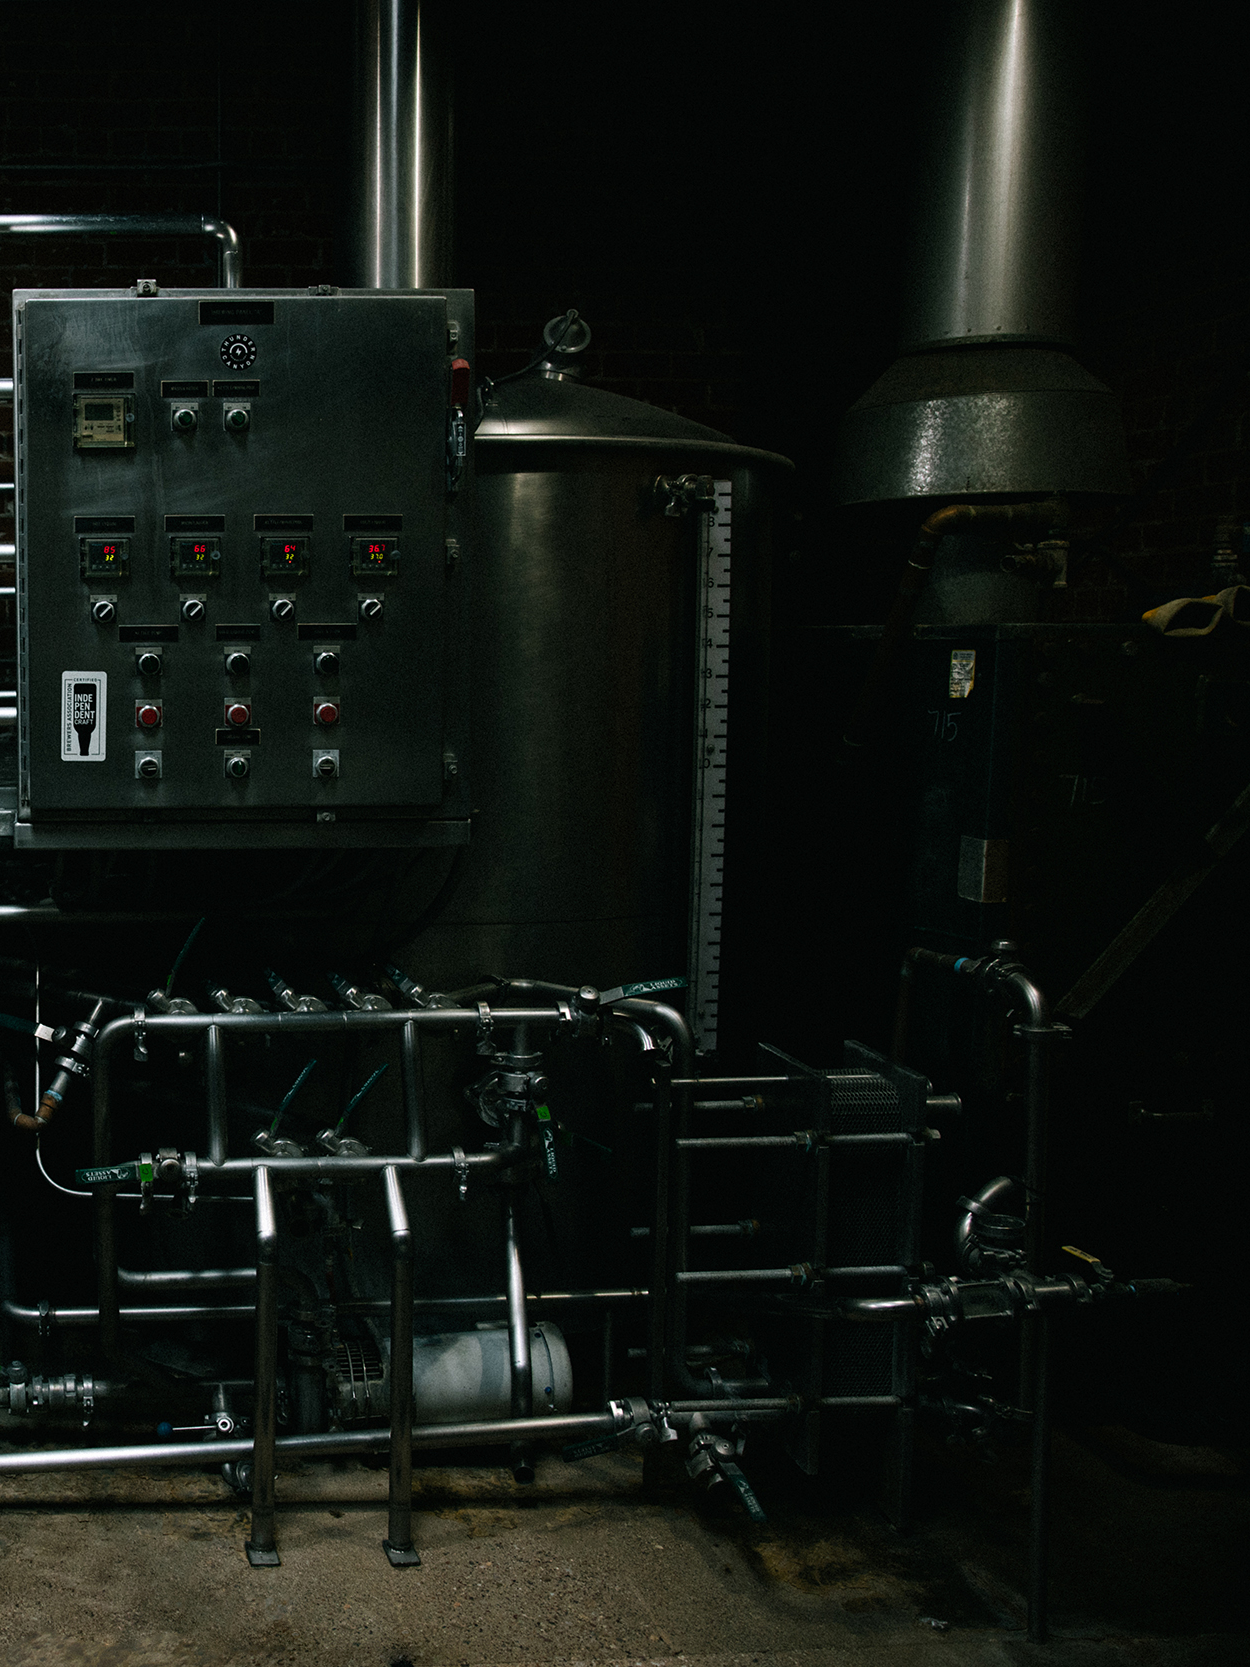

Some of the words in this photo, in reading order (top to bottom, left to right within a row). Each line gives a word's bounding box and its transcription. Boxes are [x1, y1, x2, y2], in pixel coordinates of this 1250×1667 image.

[221, 335, 256, 352] THUNDER
[222, 354, 256, 369] CANYON
[103, 545, 116, 554] 85
[194, 544, 206, 553] 66
[284, 544, 296, 553] 64
[74, 693, 93, 702] INDE
[74, 702, 91, 711] PEN
[74, 710, 95, 719] DENT
[927, 710, 962, 742] 715
[650, 979, 676, 987] LIQUID
[651, 982, 679, 990] ASSETS
[85, 1169, 111, 1177] ASSETS
